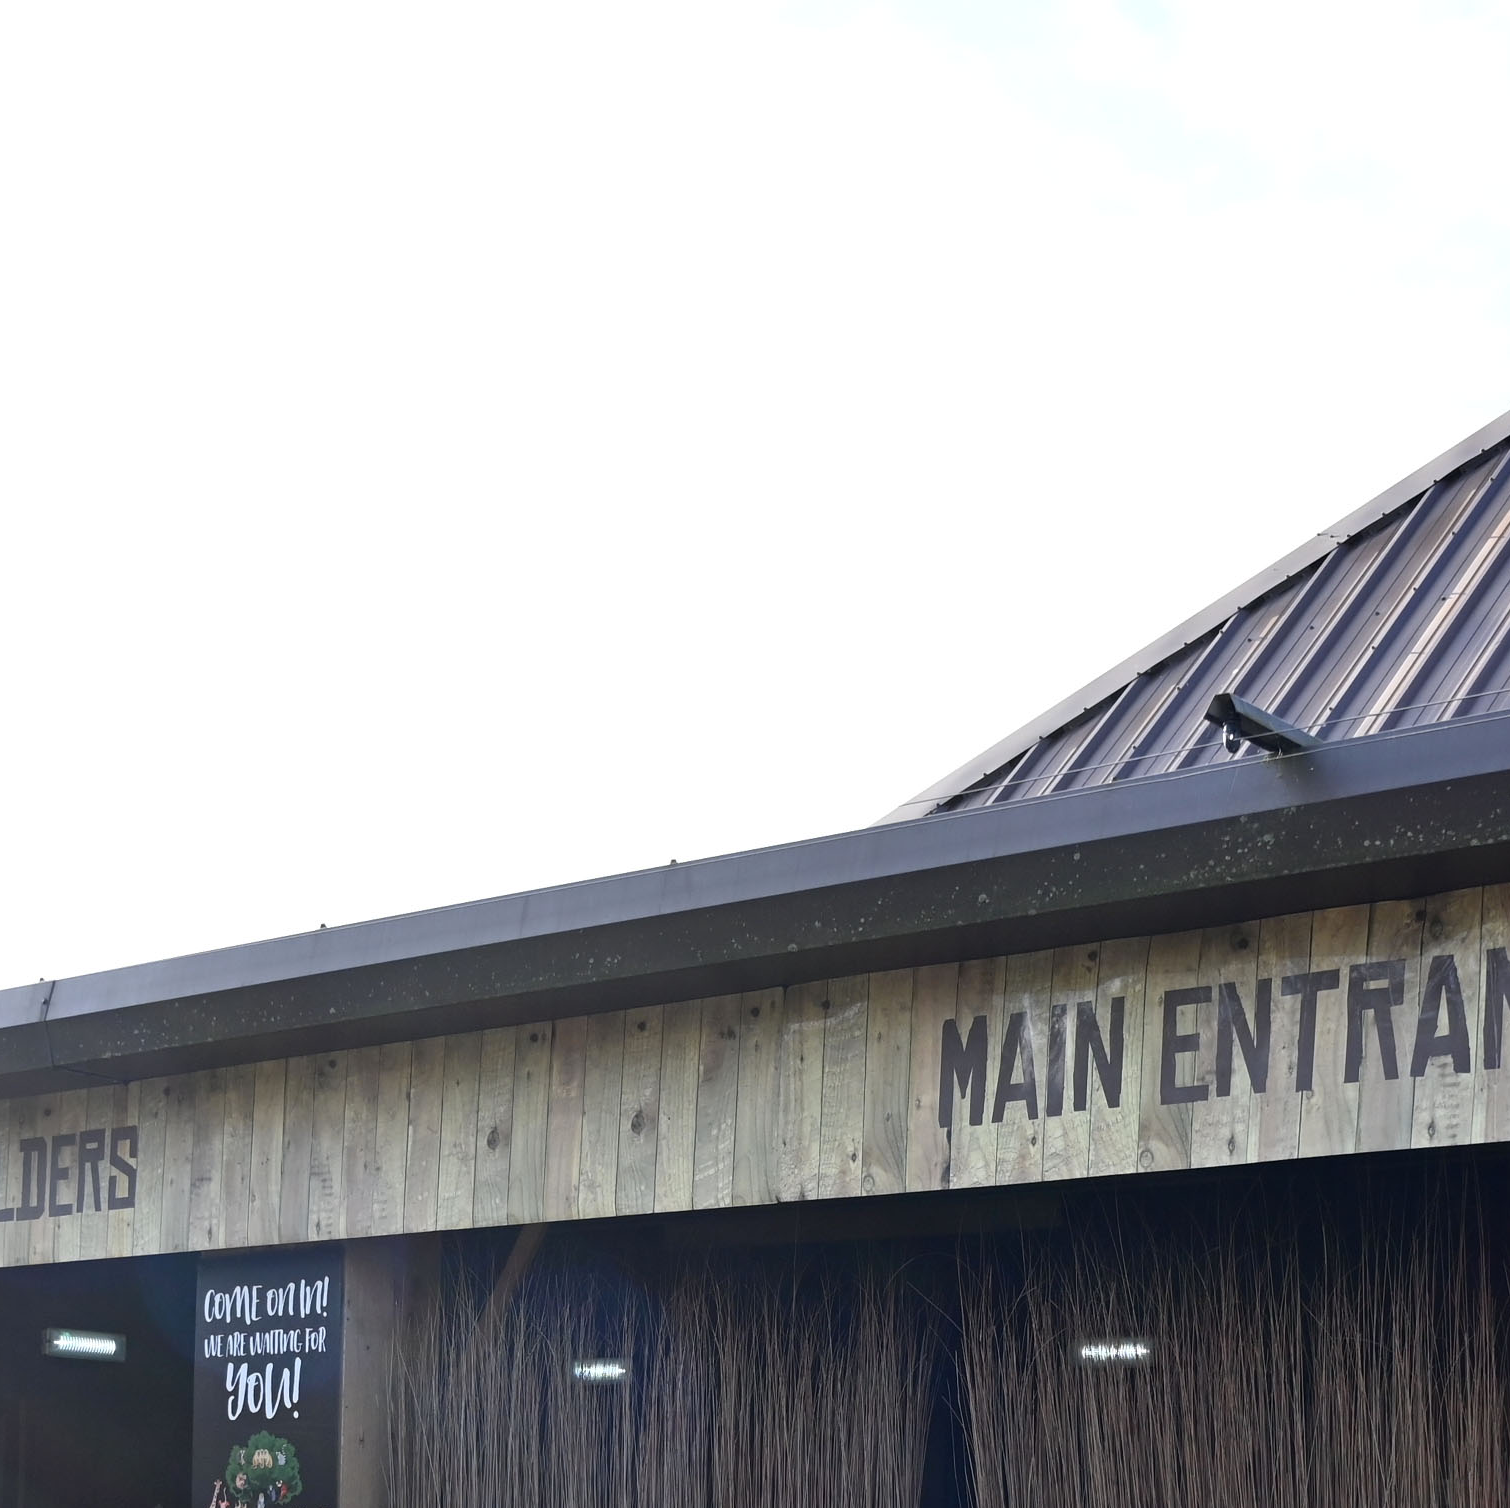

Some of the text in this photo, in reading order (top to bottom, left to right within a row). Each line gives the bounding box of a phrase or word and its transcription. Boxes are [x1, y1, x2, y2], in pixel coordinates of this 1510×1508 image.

[939, 996, 1124, 1128] MAIN
[205, 1326, 326, 1358] WE ARE WAITING FOR
[226, 1357, 301, 1420] YOU!
